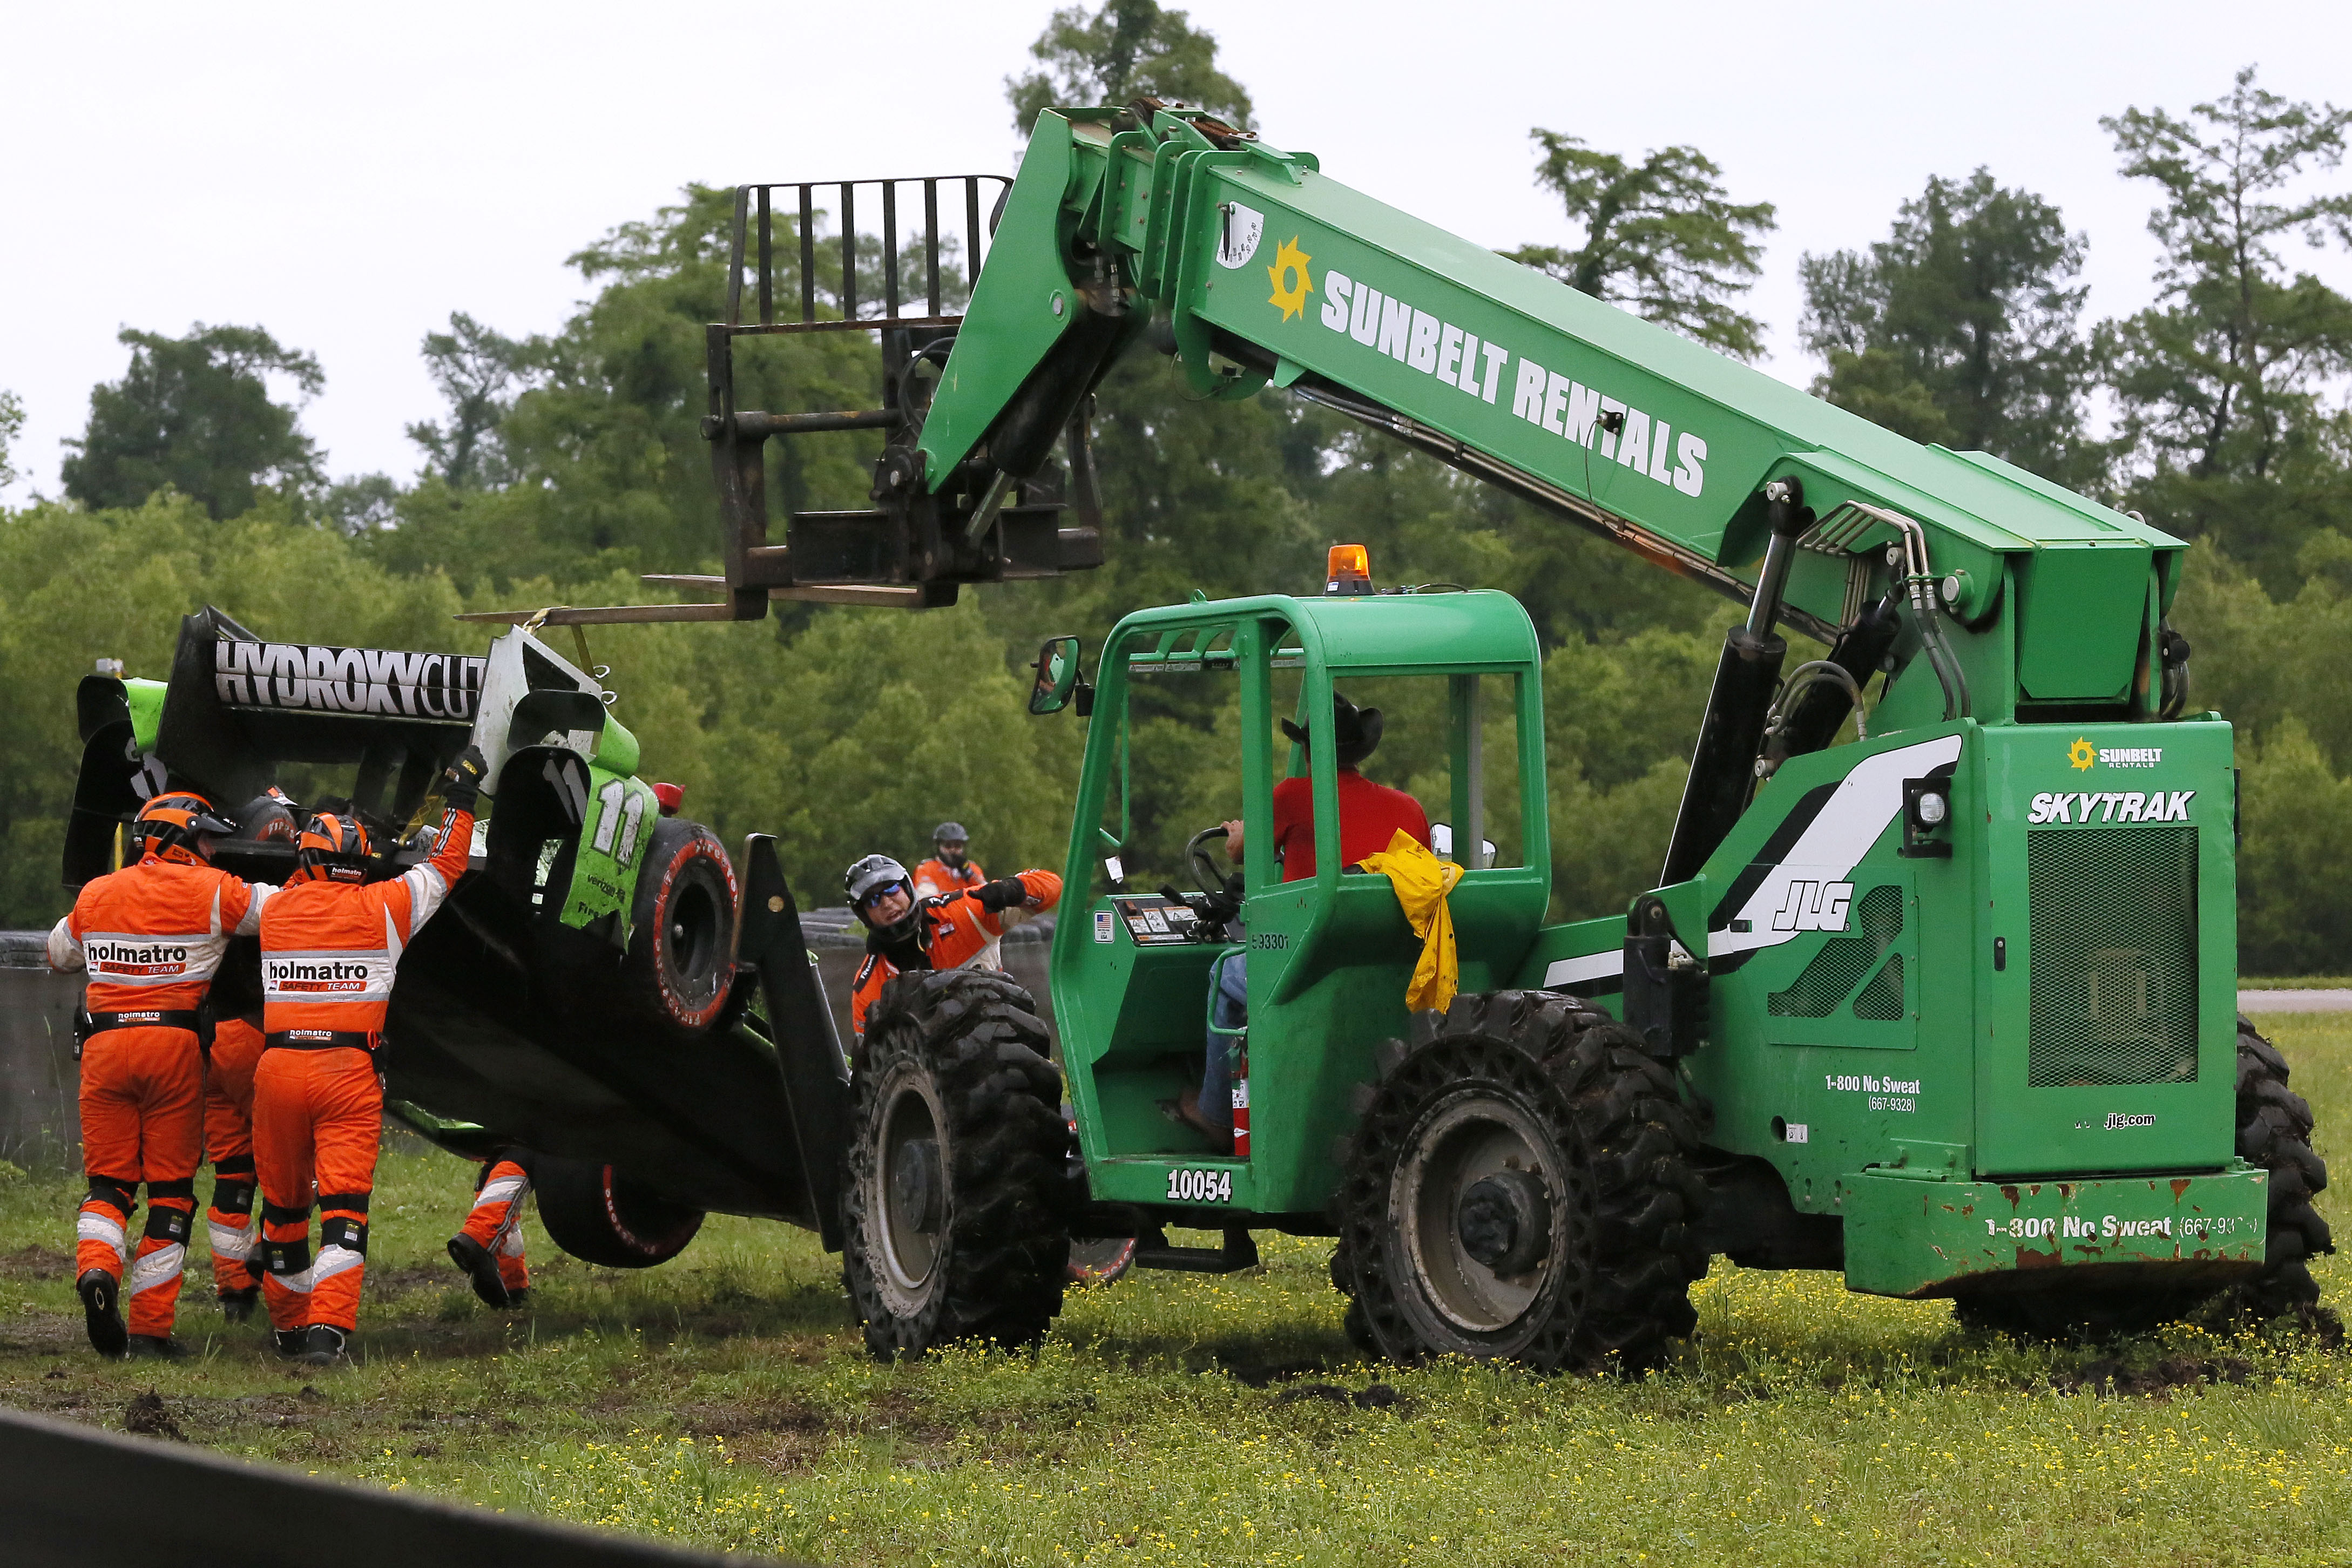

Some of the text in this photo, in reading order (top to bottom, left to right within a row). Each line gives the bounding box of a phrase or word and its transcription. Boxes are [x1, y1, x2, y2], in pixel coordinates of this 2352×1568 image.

[1321, 270, 1707, 498] SUNBELT RENTALS
[217, 641, 487, 720] HYDROXYCUT
[2099, 748, 2162, 762] SUNBELT
[2027, 790, 2196, 824] SKYTRAK
[591, 779, 644, 868] 11
[332, 867, 362, 876] holmatro
[1772, 880, 1855, 931] JLG
[88, 942, 187, 963] holmatro
[103, 963, 179, 974] SAFETY TEAM
[270, 961, 368, 979] holmatro
[282, 982, 360, 990] SAFETY TEAM
[1825, 1074, 1921, 1094] 1-800 No Sweat
[1868, 1095, 1915, 1113] (667-9328)
[2074, 1113, 2156, 1130] .jlg.com
[1166, 1168, 1233, 1202] 10054
[1985, 1215, 2258, 1239] 1-800 No Sweat (667-93)
